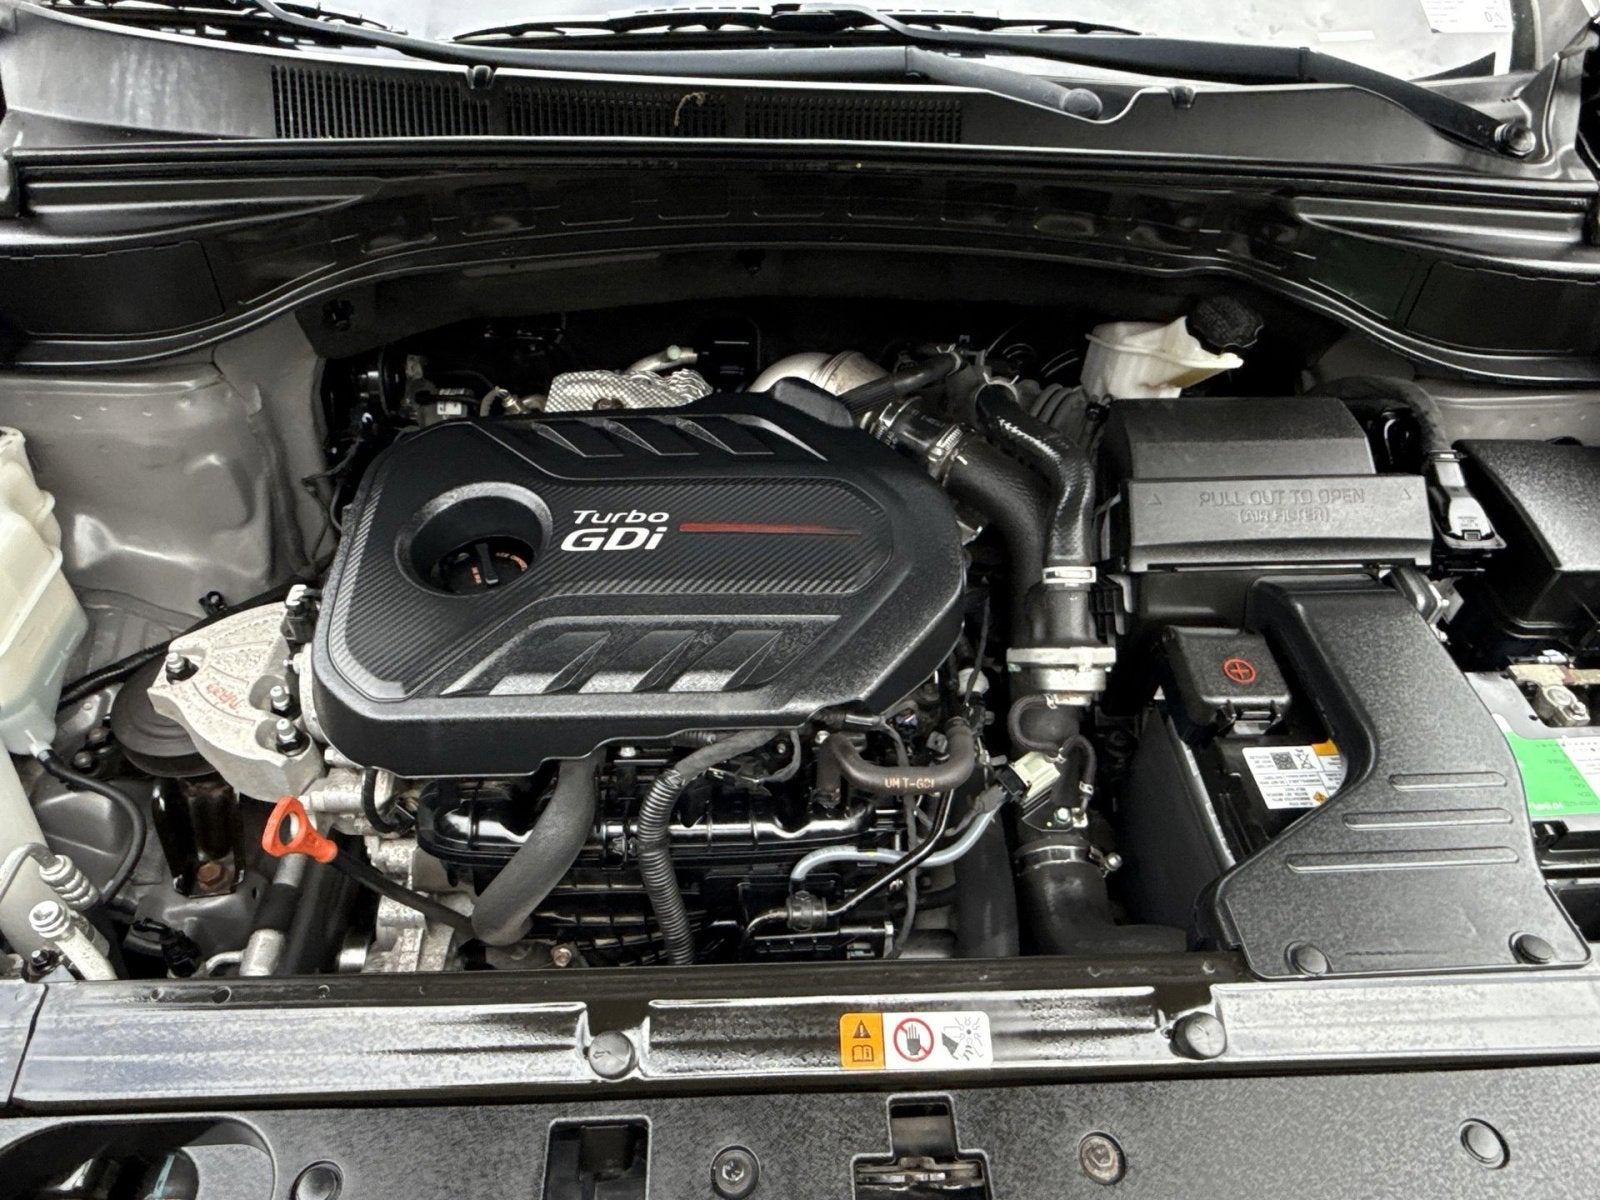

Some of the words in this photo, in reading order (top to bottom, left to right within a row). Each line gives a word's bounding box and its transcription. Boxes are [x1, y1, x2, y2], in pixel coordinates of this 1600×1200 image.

[1199, 490, 1245, 507] PULL
[1249, 489, 1285, 506] OUT
[1289, 488, 1313, 505] TO
[1318, 486, 1366, 504] OPEN
[573, 510, 669, 524] Turbo
[1239, 507, 1270, 524] (AIR
[560, 526, 668, 551] GDi
